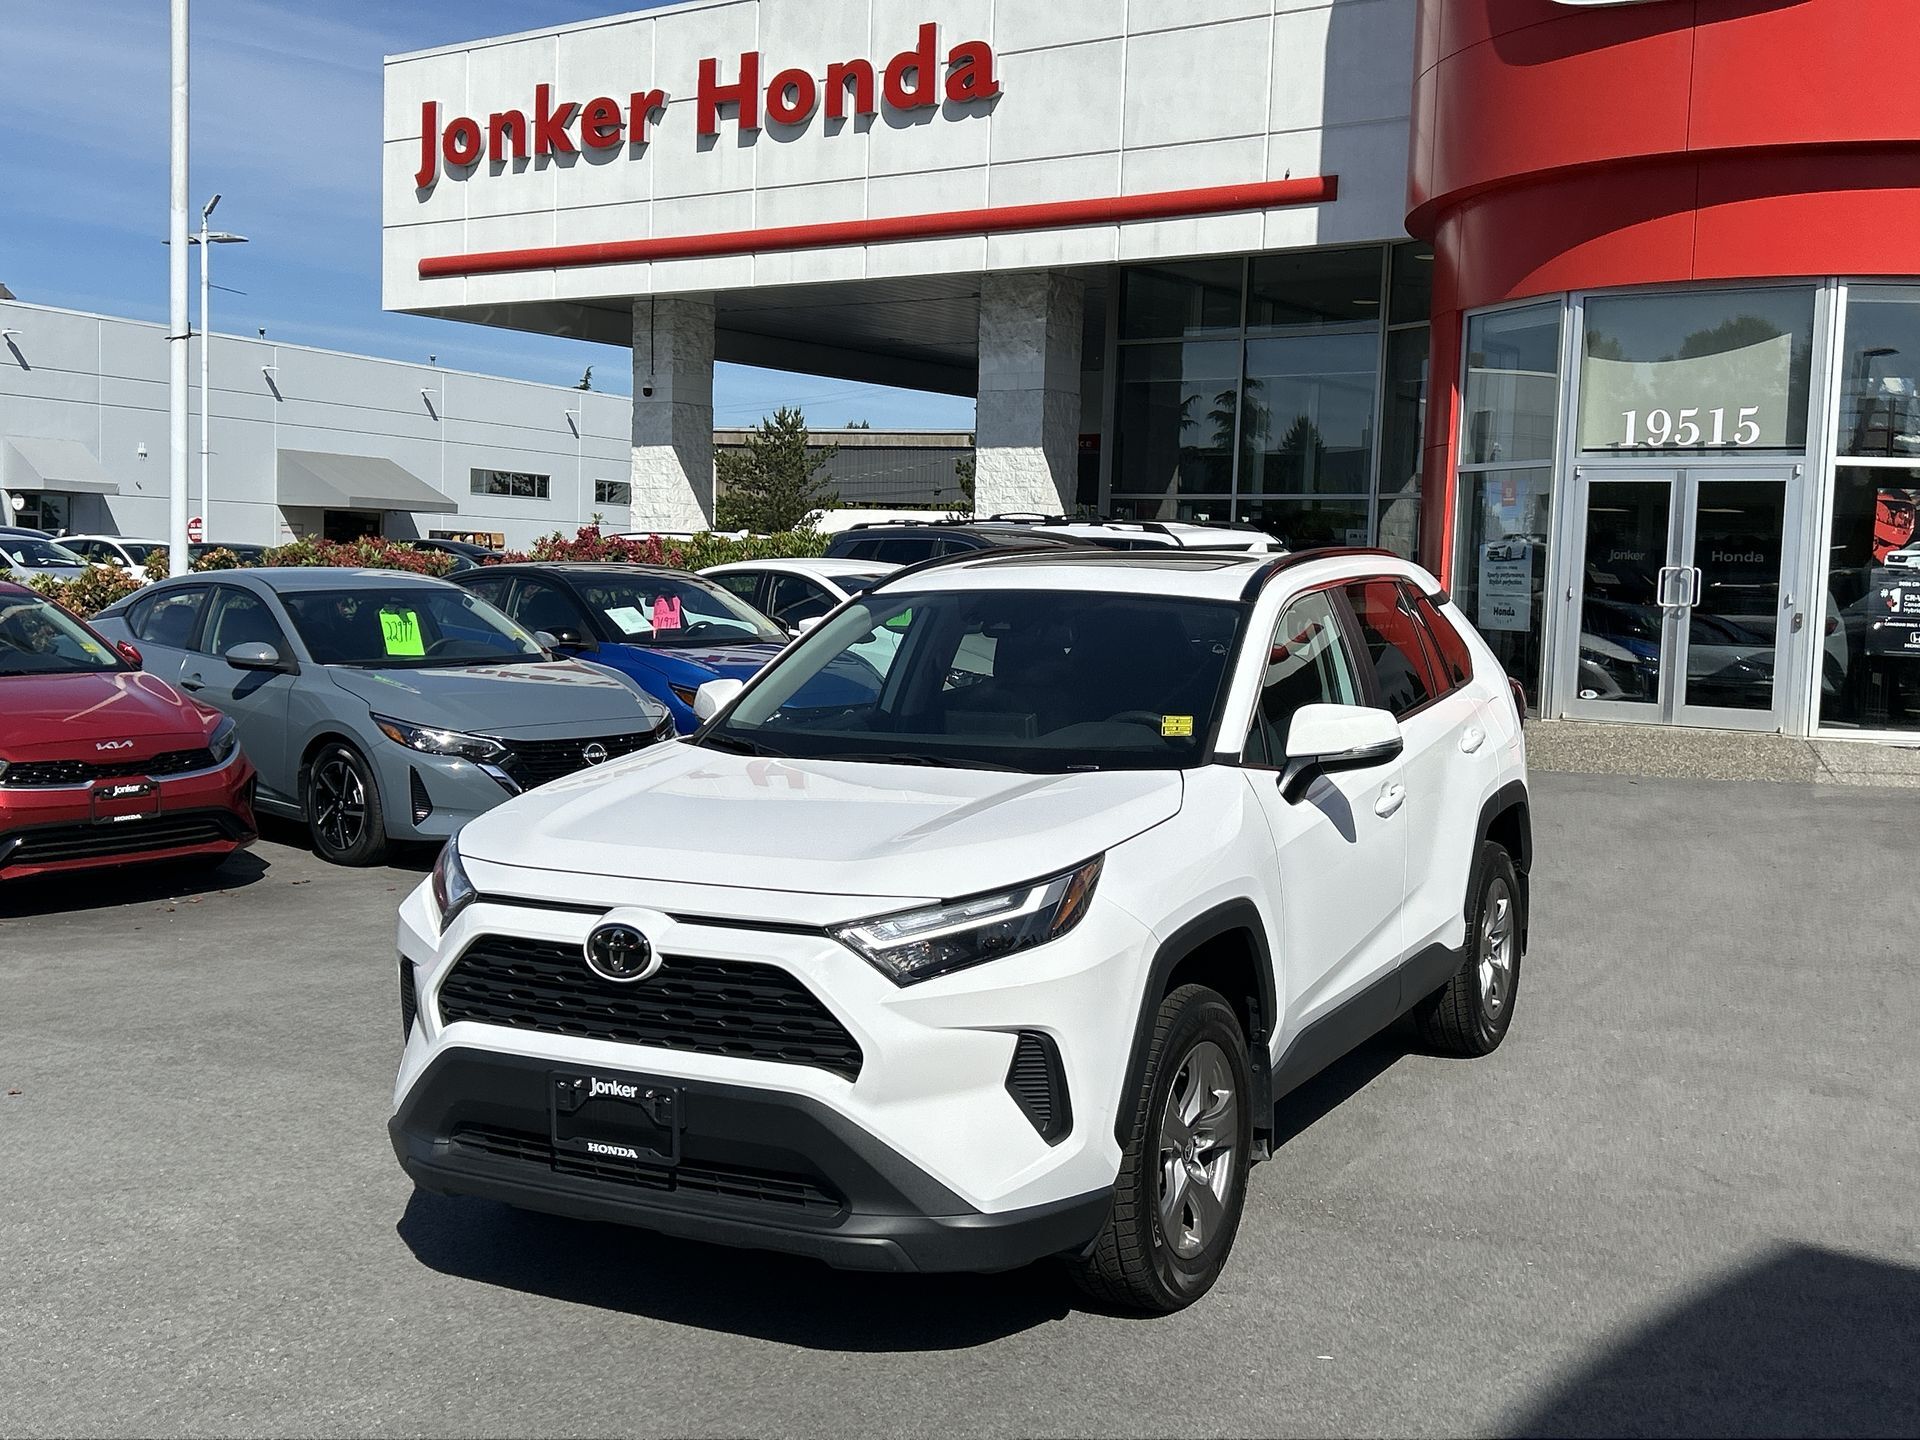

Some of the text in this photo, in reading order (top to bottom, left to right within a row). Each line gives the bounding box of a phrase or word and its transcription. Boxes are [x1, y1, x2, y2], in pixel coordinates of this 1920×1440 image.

[415, 22, 1000, 189] Jonker Honda
[1620, 406, 1760, 446] 19515
[1608, 549, 1765, 563] Jonker Honda
[1493, 606, 1516, 616] Honda
[583, 751, 608, 759] NISSAN
[112, 784, 141, 797] Jonker
[113, 813, 142, 822] HONDA
[589, 1076, 638, 1098] Jonker
[587, 1142, 639, 1159] HONDA
